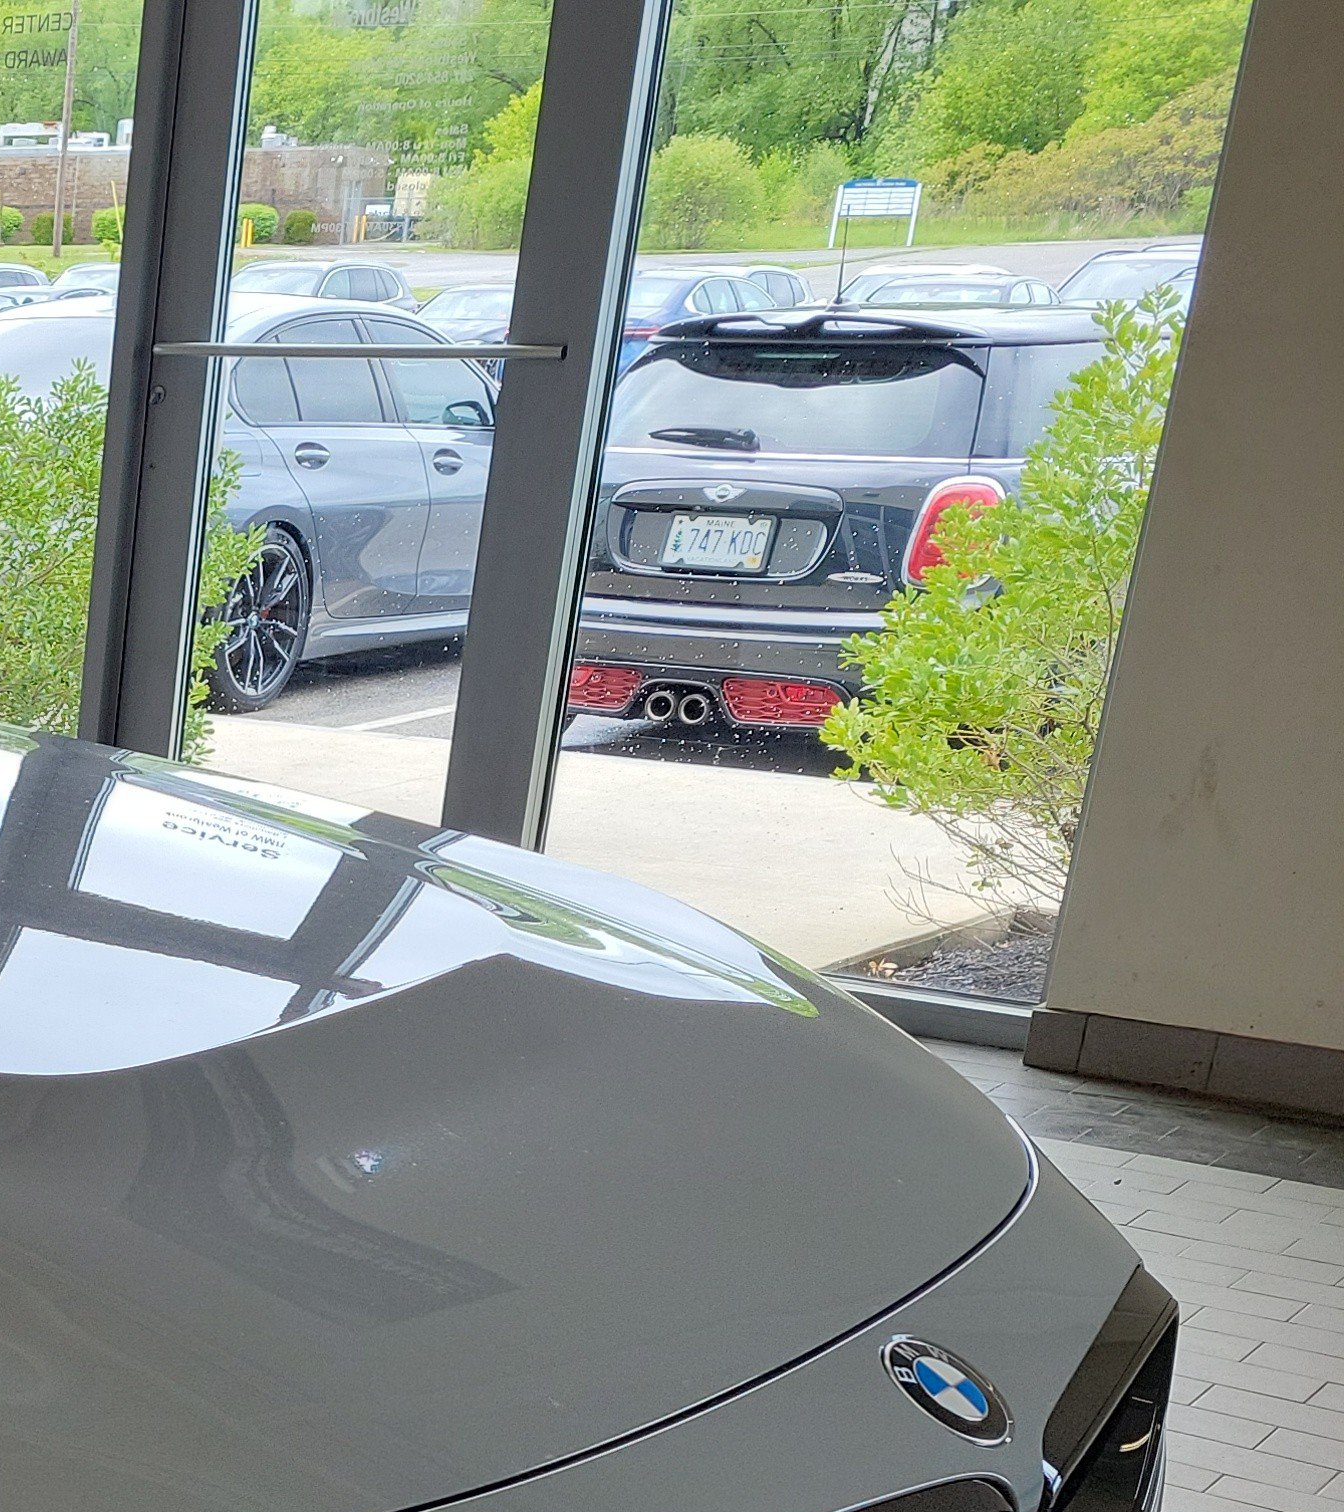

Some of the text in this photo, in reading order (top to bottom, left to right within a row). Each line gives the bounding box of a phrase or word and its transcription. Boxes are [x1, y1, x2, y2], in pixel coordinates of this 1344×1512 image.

[707, 519, 736, 529] MAINE
[688, 528, 766, 556] 747 KDC
[162, 820, 281, 860] Service
